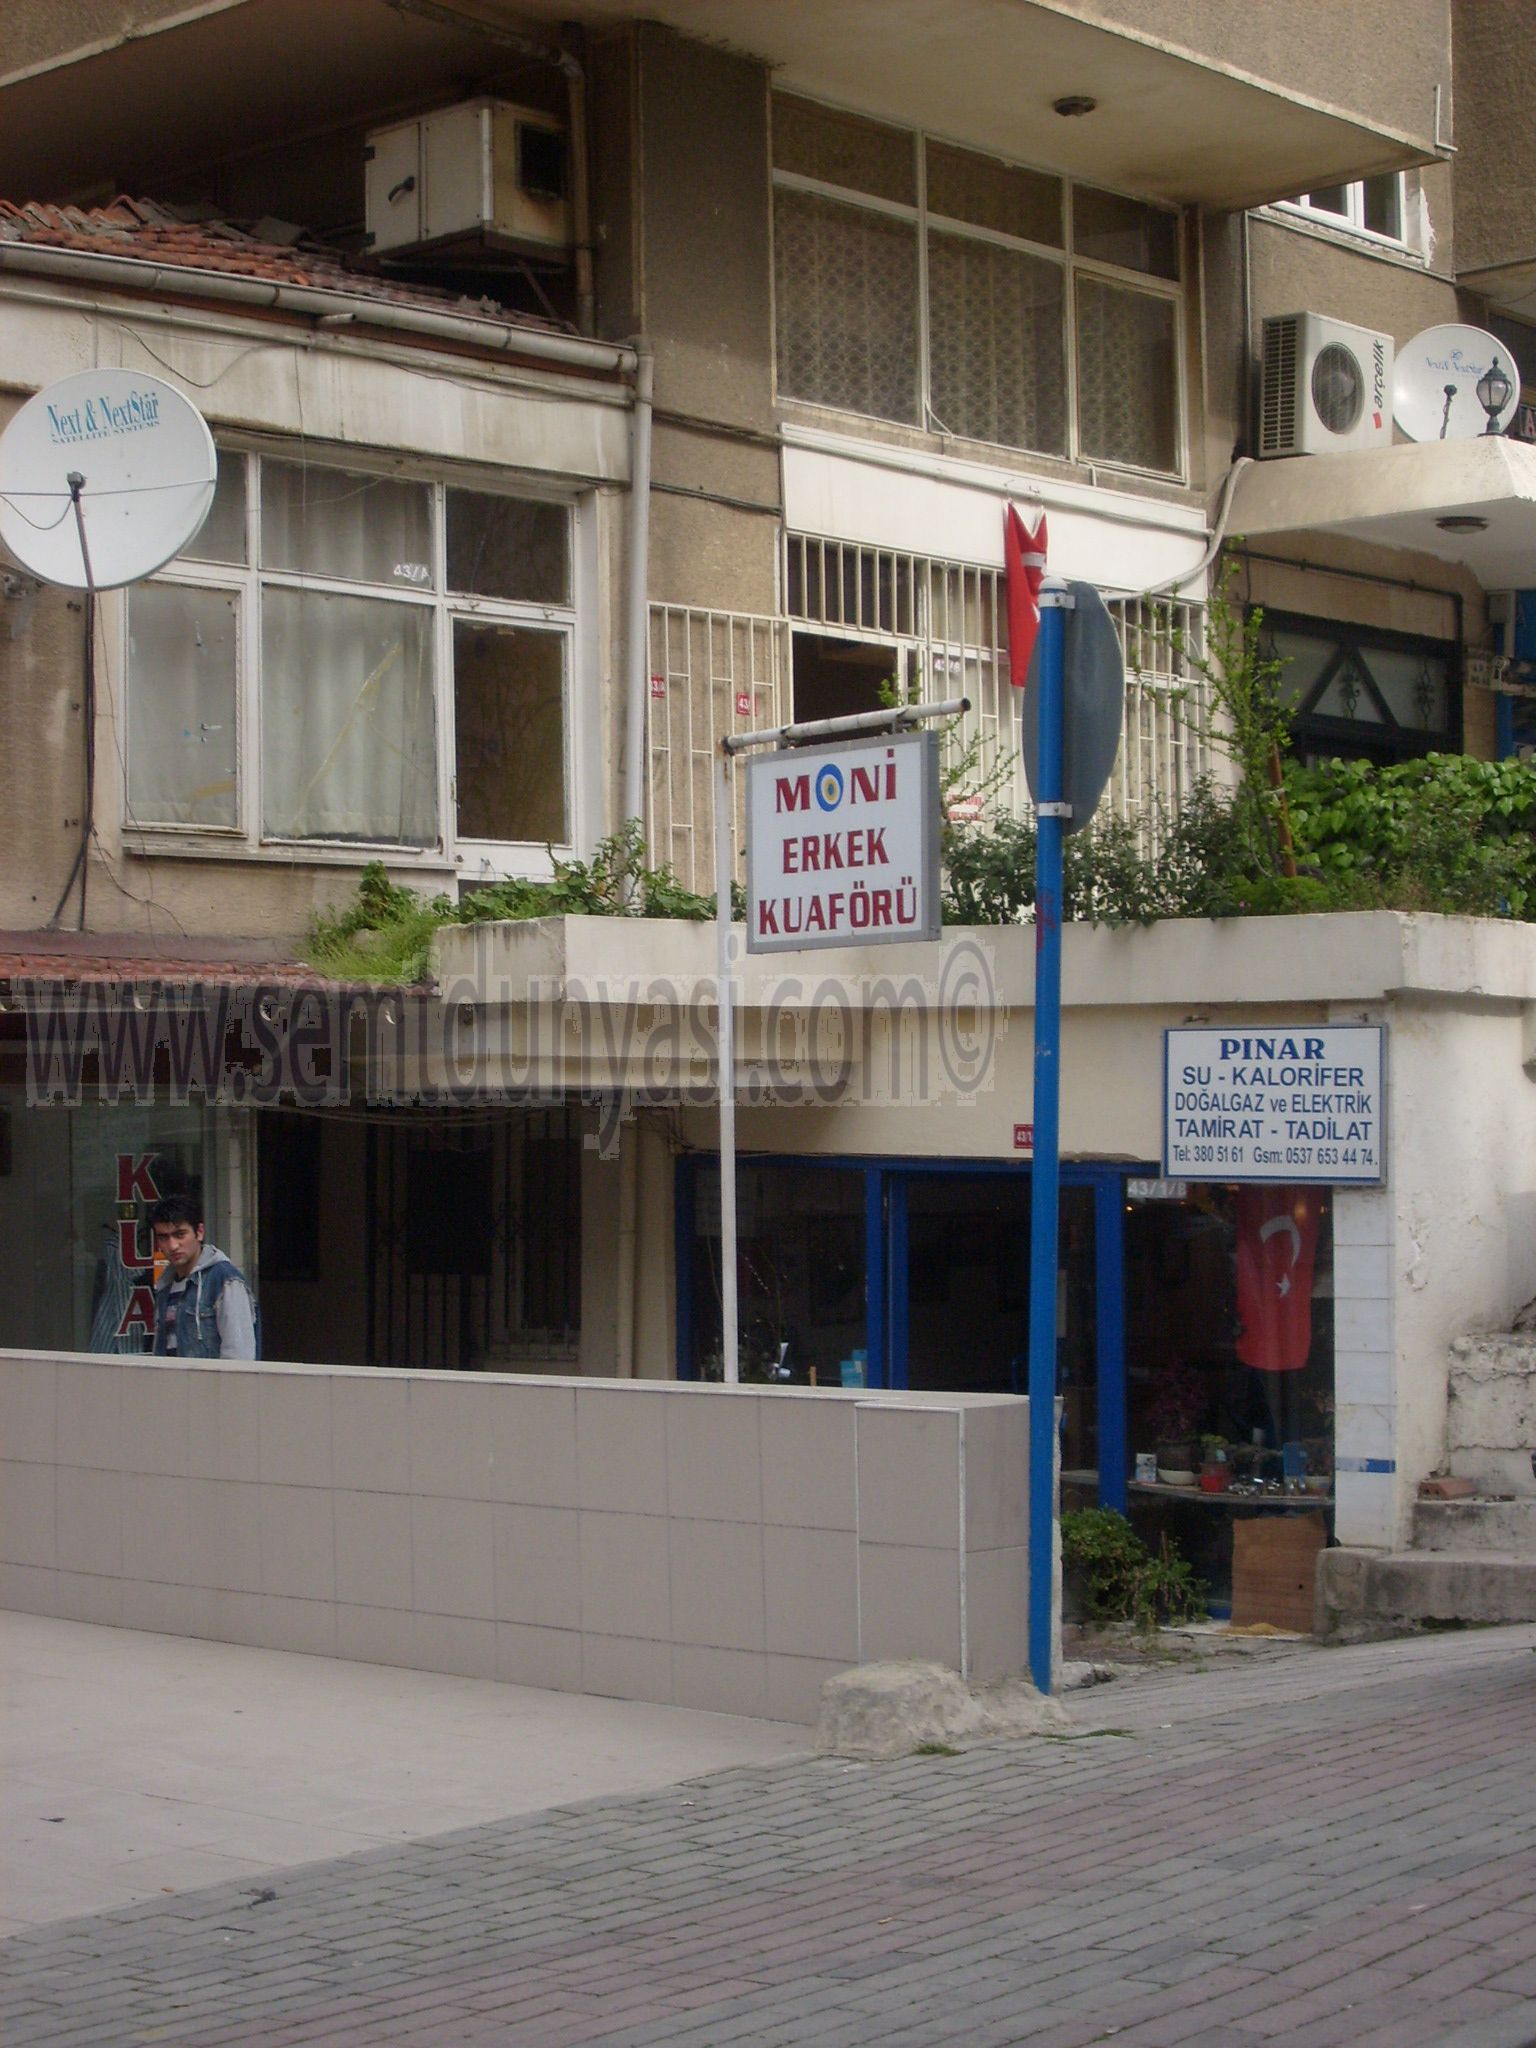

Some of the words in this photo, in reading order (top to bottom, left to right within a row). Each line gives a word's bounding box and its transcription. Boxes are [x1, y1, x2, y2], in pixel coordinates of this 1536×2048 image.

[1372, 339, 1386, 409] arçelik
[47, 404, 82, 436] Next
[85, 400, 99, 432] &
[775, 748, 897, 814] MONİ
[782, 827, 890, 874] ERKEK
[759, 876, 917, 935] KUAFÖRÜ
[1219, 1038, 1326, 1060] PINAR
[1182, 1066, 1211, 1086] SU
[1232, 1062, 1364, 1087] KALORİFER
[1175, 1088, 1264, 1112] DOĞALGAZ
[1270, 1099, 1287, 1112] ve
[1292, 1090, 1372, 1114] ELEKTRİK
[1175, 1115, 1264, 1139] TAMİRAT
[1285, 1117, 1373, 1141] TADİLAT
[1173, 1145, 1191, 1162] Tel:
[1194, 1145, 1214, 1162] 380
[1253, 1147, 1282, 1163] Gsm:
[1286, 1147, 1312, 1164] 0537
[1318, 1147, 1338, 1164] 653
[1343, 1148, 1356, 1165] 44
[115, 1153, 162, 1356] KUA
